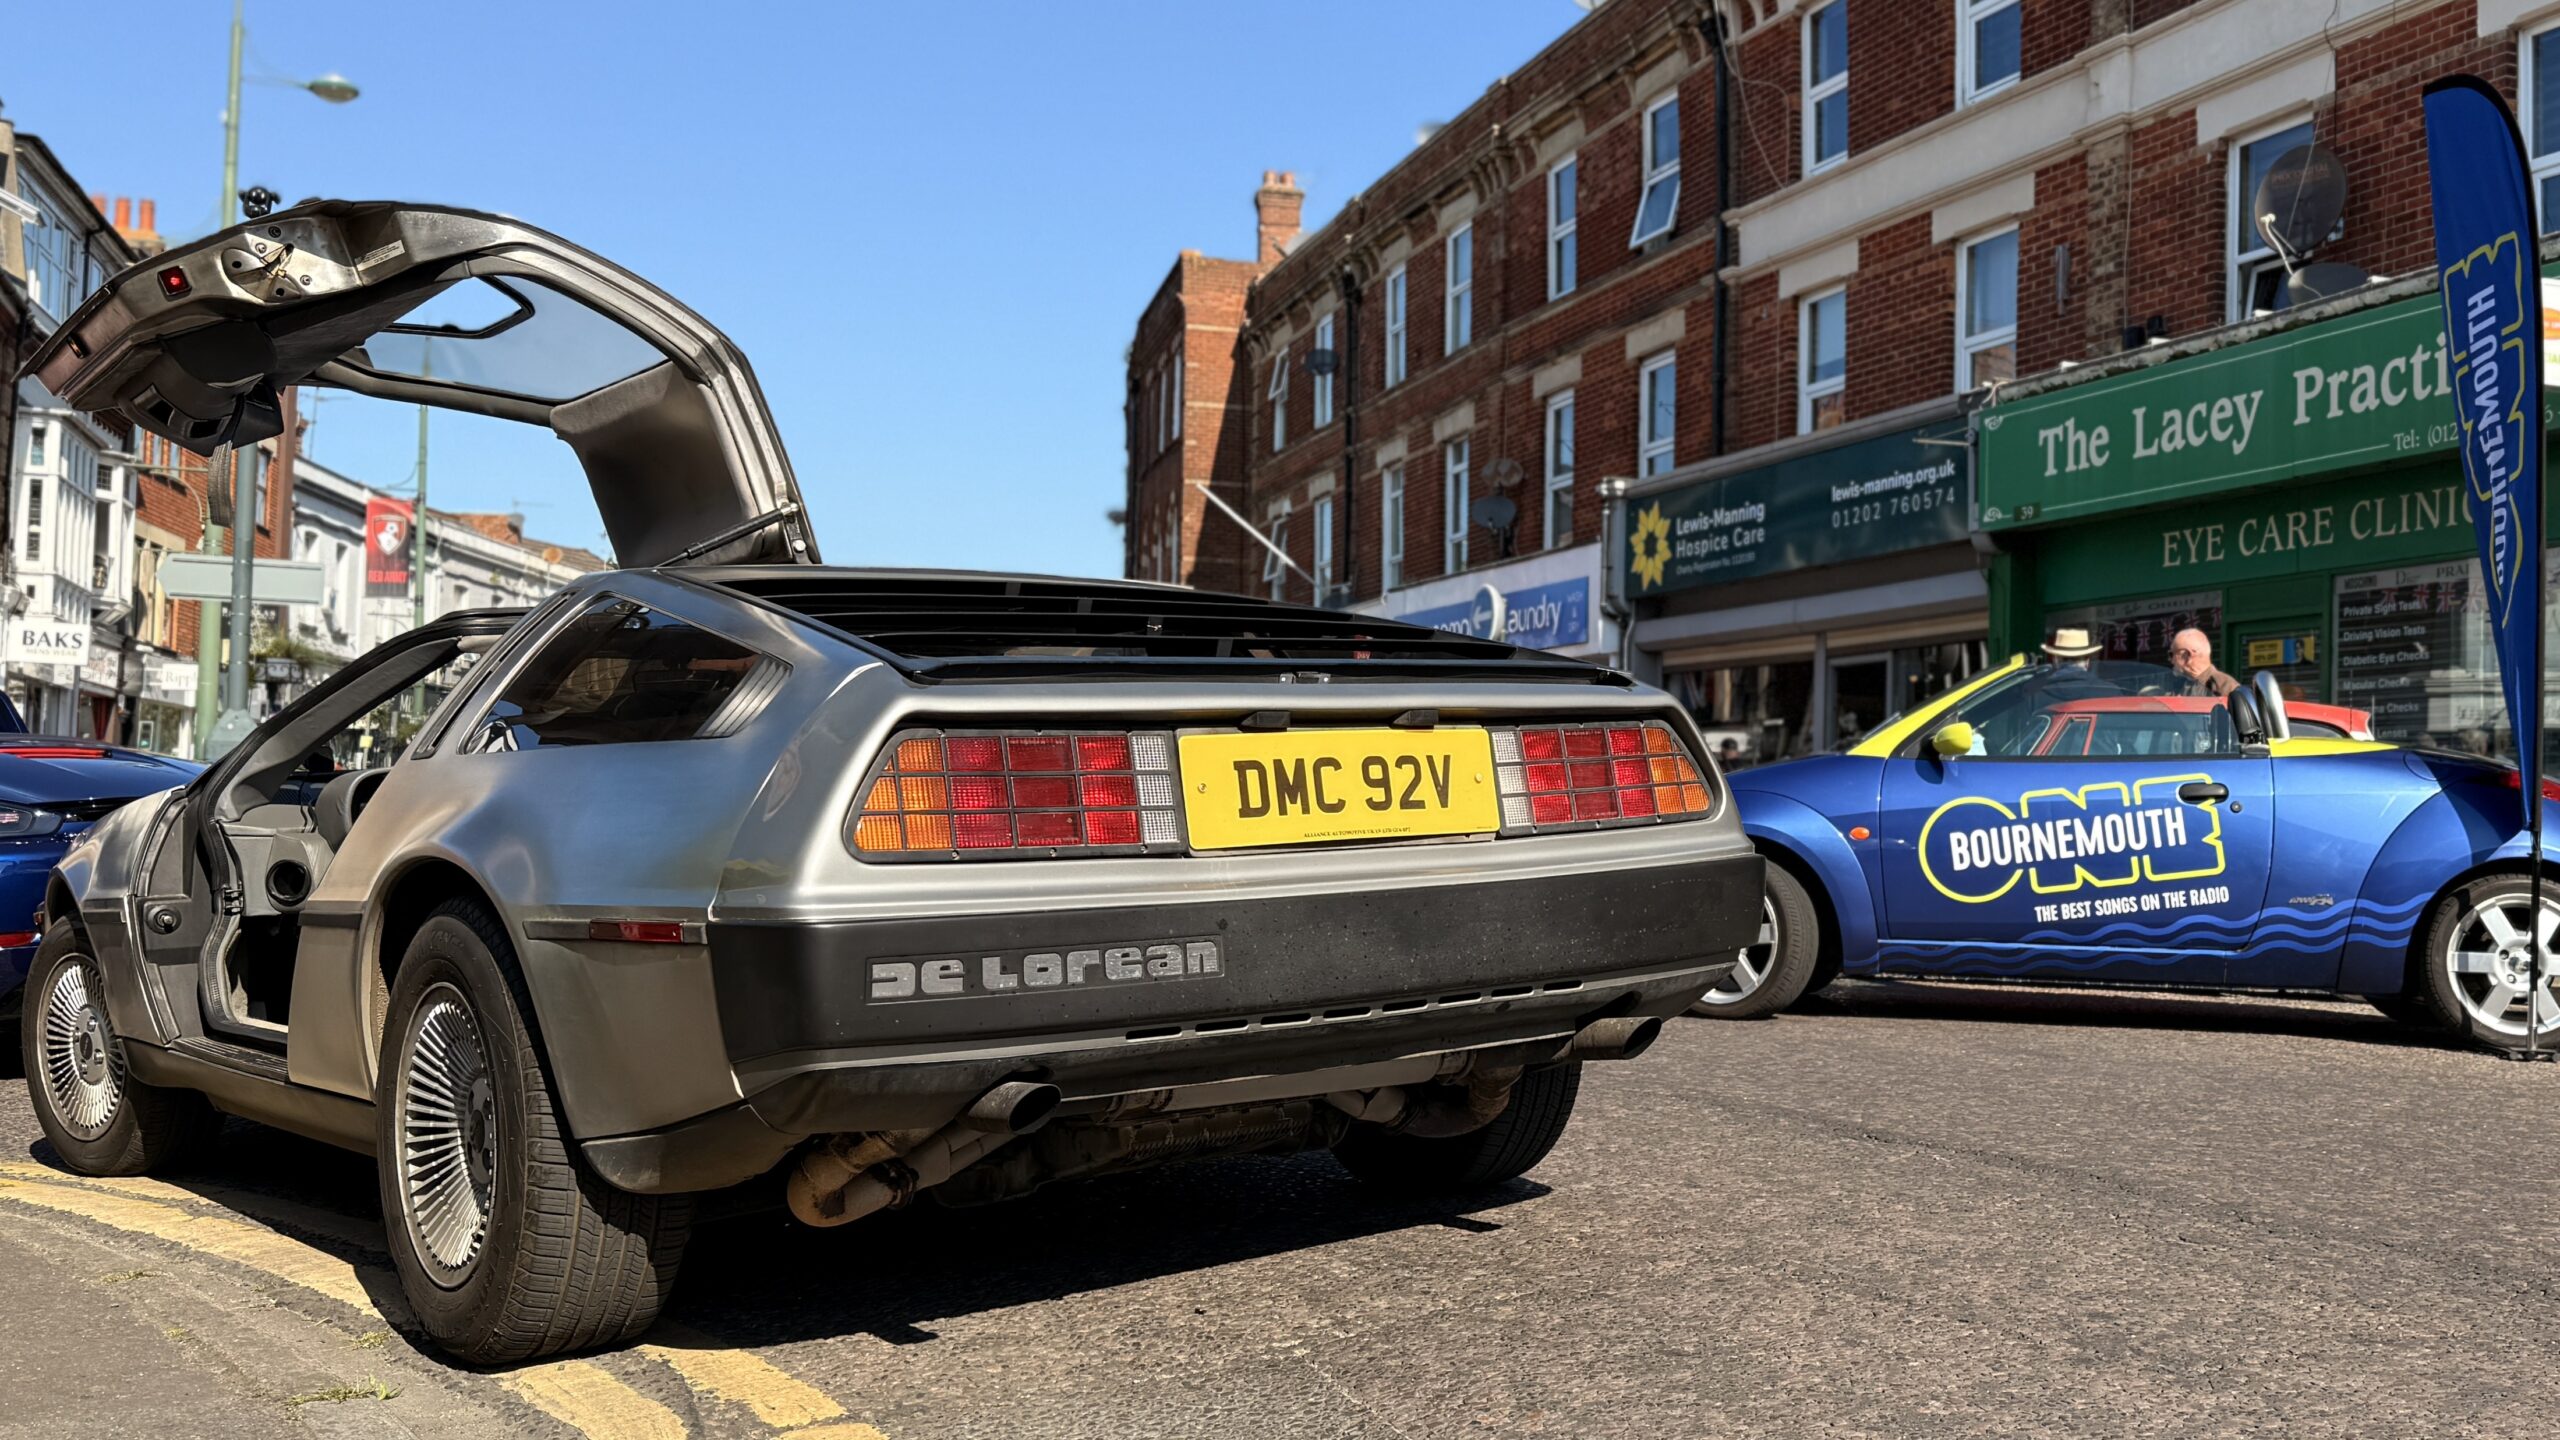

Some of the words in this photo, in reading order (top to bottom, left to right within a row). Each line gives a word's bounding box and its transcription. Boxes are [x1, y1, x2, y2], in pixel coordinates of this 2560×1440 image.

[2039, 416, 2110, 477] The
[2132, 389, 2264, 460] Lacey
[2394, 430, 2421, 452] Tel:
[1831, 459, 1956, 502] lewis-manning.org.uk
[1676, 501, 1766, 536] Lewis-Manning
[1832, 502, 1881, 528] 01202
[1889, 486, 1955, 515] 760574
[2020, 505, 2034, 520] 39
[1676, 533, 1729, 558] Hospice
[1733, 526, 1765, 548] Care
[2162, 524, 2226, 568] EYE
[2238, 506, 2335, 557] CARE
[2343, 604, 2372, 617] Private
[2374, 601, 2397, 616] Sight
[2399, 599, 2421, 611] Tests
[21, 629, 84, 649] BAKS
[2343, 630, 2374, 642] Driving
[2375, 628, 2401, 639] Vision
[2403, 625, 2427, 637] Tests
[2343, 654, 2377, 667] Diabetic
[2378, 652, 2395, 665] Eye
[2396, 650, 2430, 663] Checks
[2343, 678, 2376, 690] Macular
[2386, 702, 2419, 713] Checks
[2376, 728, 2408, 738] Lenses
[1233, 757, 1346, 818] DMC
[1361, 754, 1451, 812] 92V
[1949, 806, 2187, 872] BOURNEMOUTH
[2034, 905, 2058, 923] THE
[2061, 901, 2091, 921] BEST
[2095, 897, 2138, 917] SONGS
[2141, 895, 2160, 912] ON
[2163, 891, 2187, 909] THE
[2190, 886, 2230, 906] RADIO
